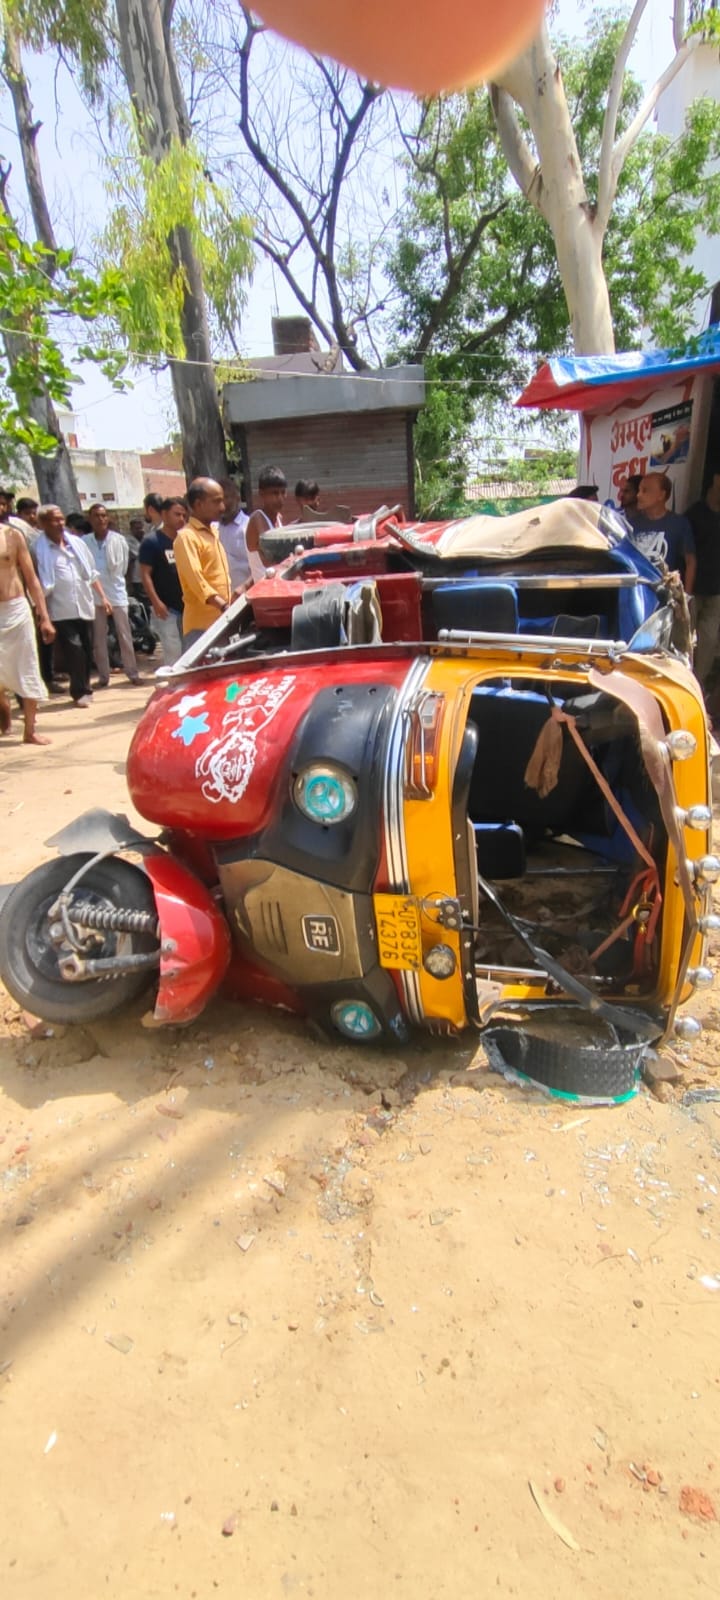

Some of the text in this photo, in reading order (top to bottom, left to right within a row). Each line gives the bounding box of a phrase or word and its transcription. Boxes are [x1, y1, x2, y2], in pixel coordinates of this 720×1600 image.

[610, 413, 654, 453] अमूल
[612, 456, 649, 501] दध
[309, 920, 329, 948] RE
[378, 910, 399, 960] T4376
